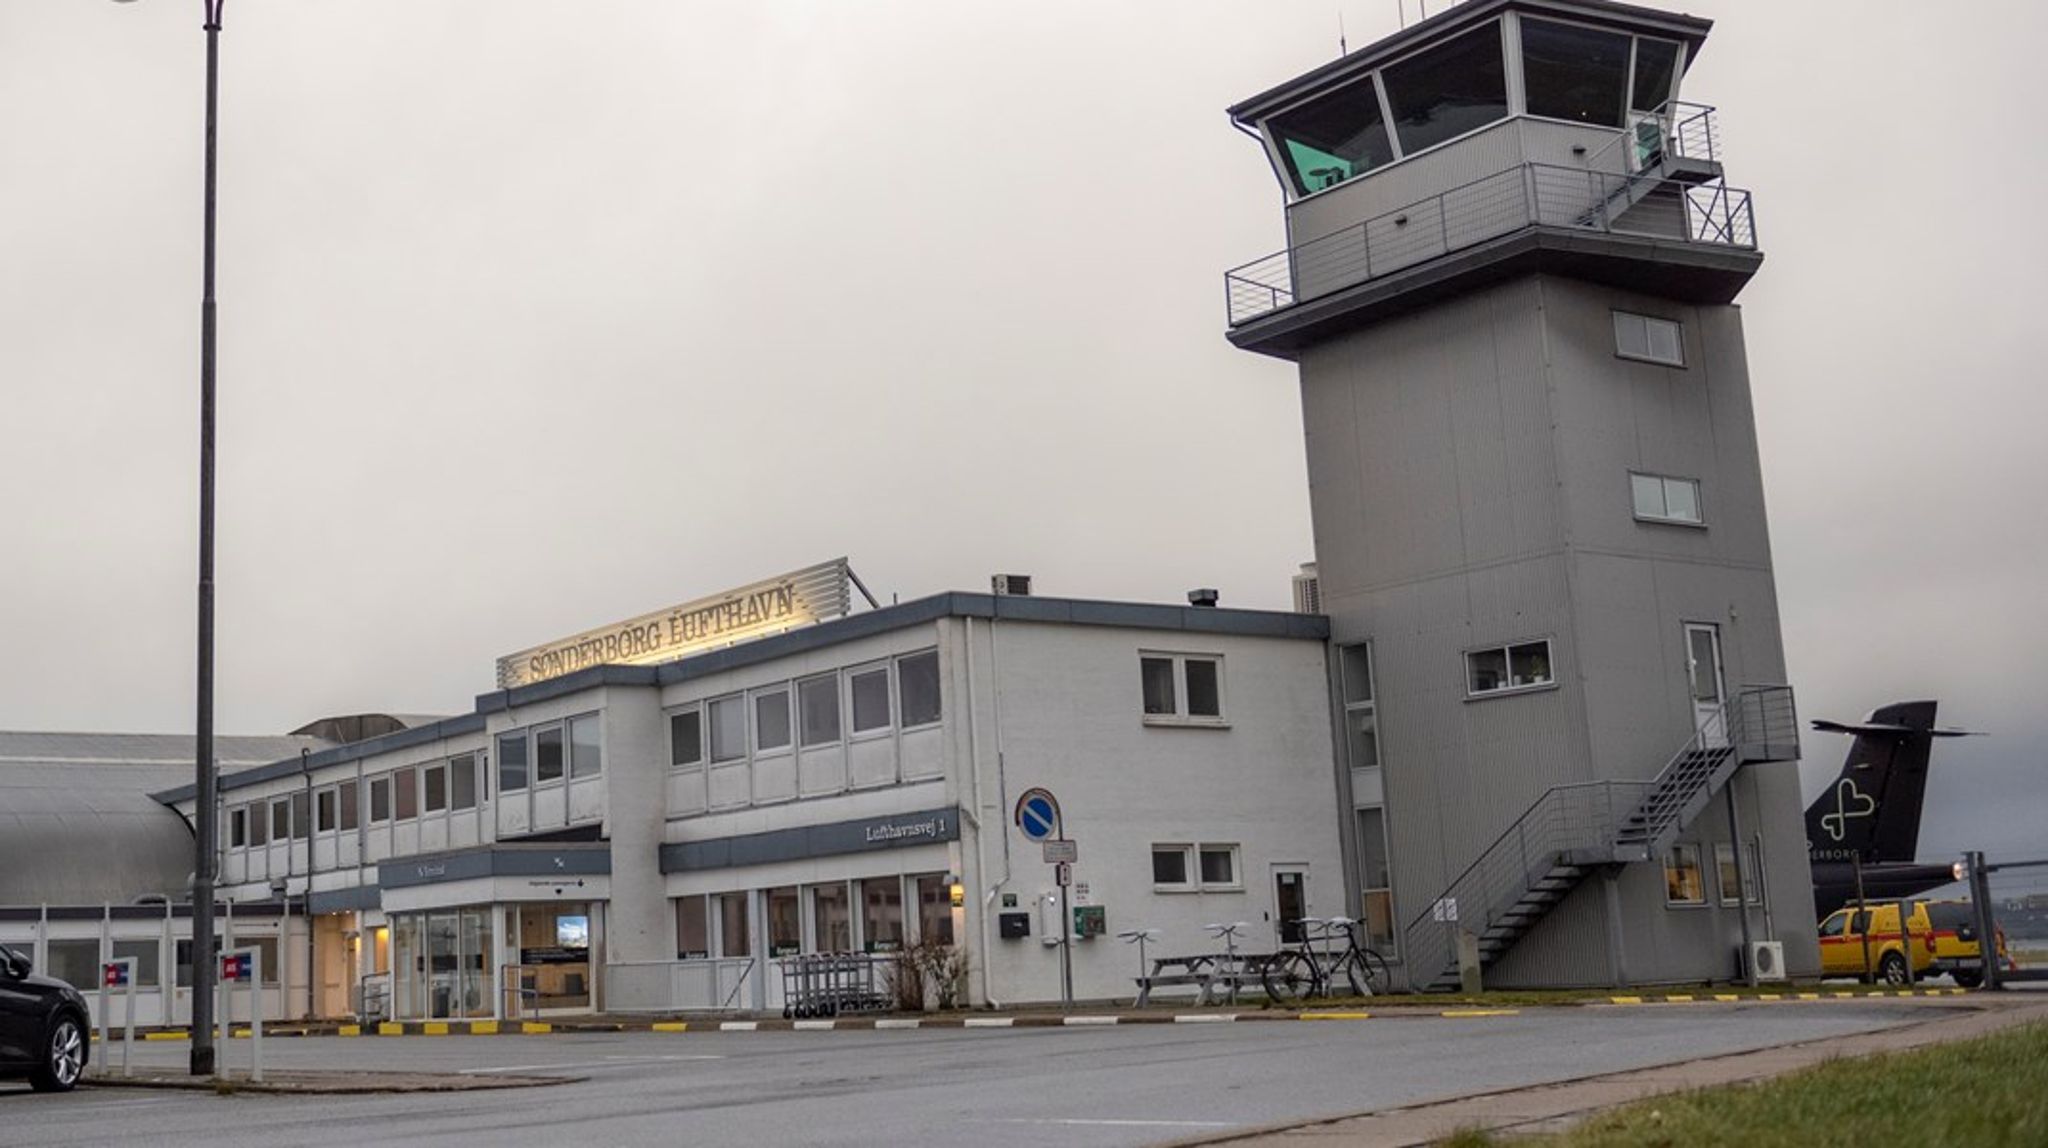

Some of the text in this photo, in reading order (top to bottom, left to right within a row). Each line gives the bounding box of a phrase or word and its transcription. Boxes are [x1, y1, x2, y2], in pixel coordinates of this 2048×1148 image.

[668, 583, 795, 645] LUFTHAVN
[865, 818, 946, 841] Lufthavnsvej 1
